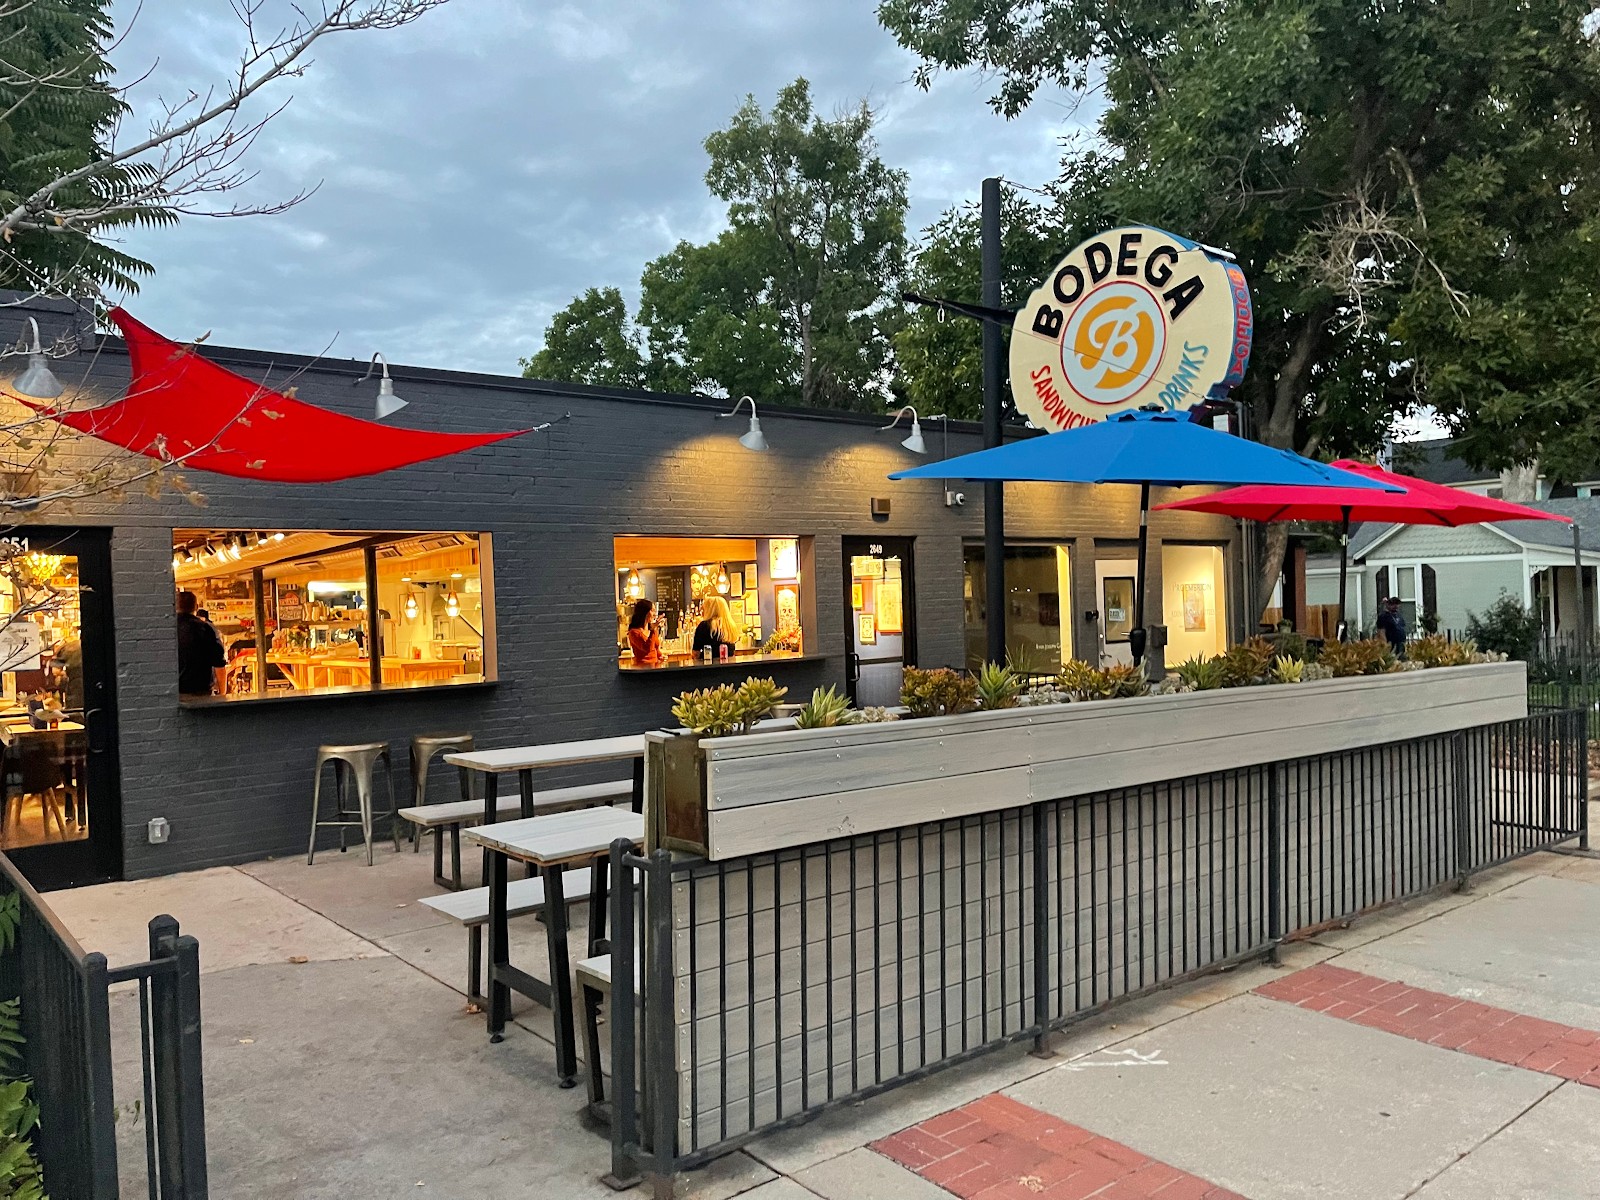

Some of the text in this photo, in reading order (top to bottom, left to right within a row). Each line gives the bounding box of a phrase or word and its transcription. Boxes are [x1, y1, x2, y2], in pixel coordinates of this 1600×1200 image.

[1032, 233, 1204, 339] BODEGA
[1227, 268, 1252, 377] BODEGA
[1158, 340, 1209, 412] DRINKS
